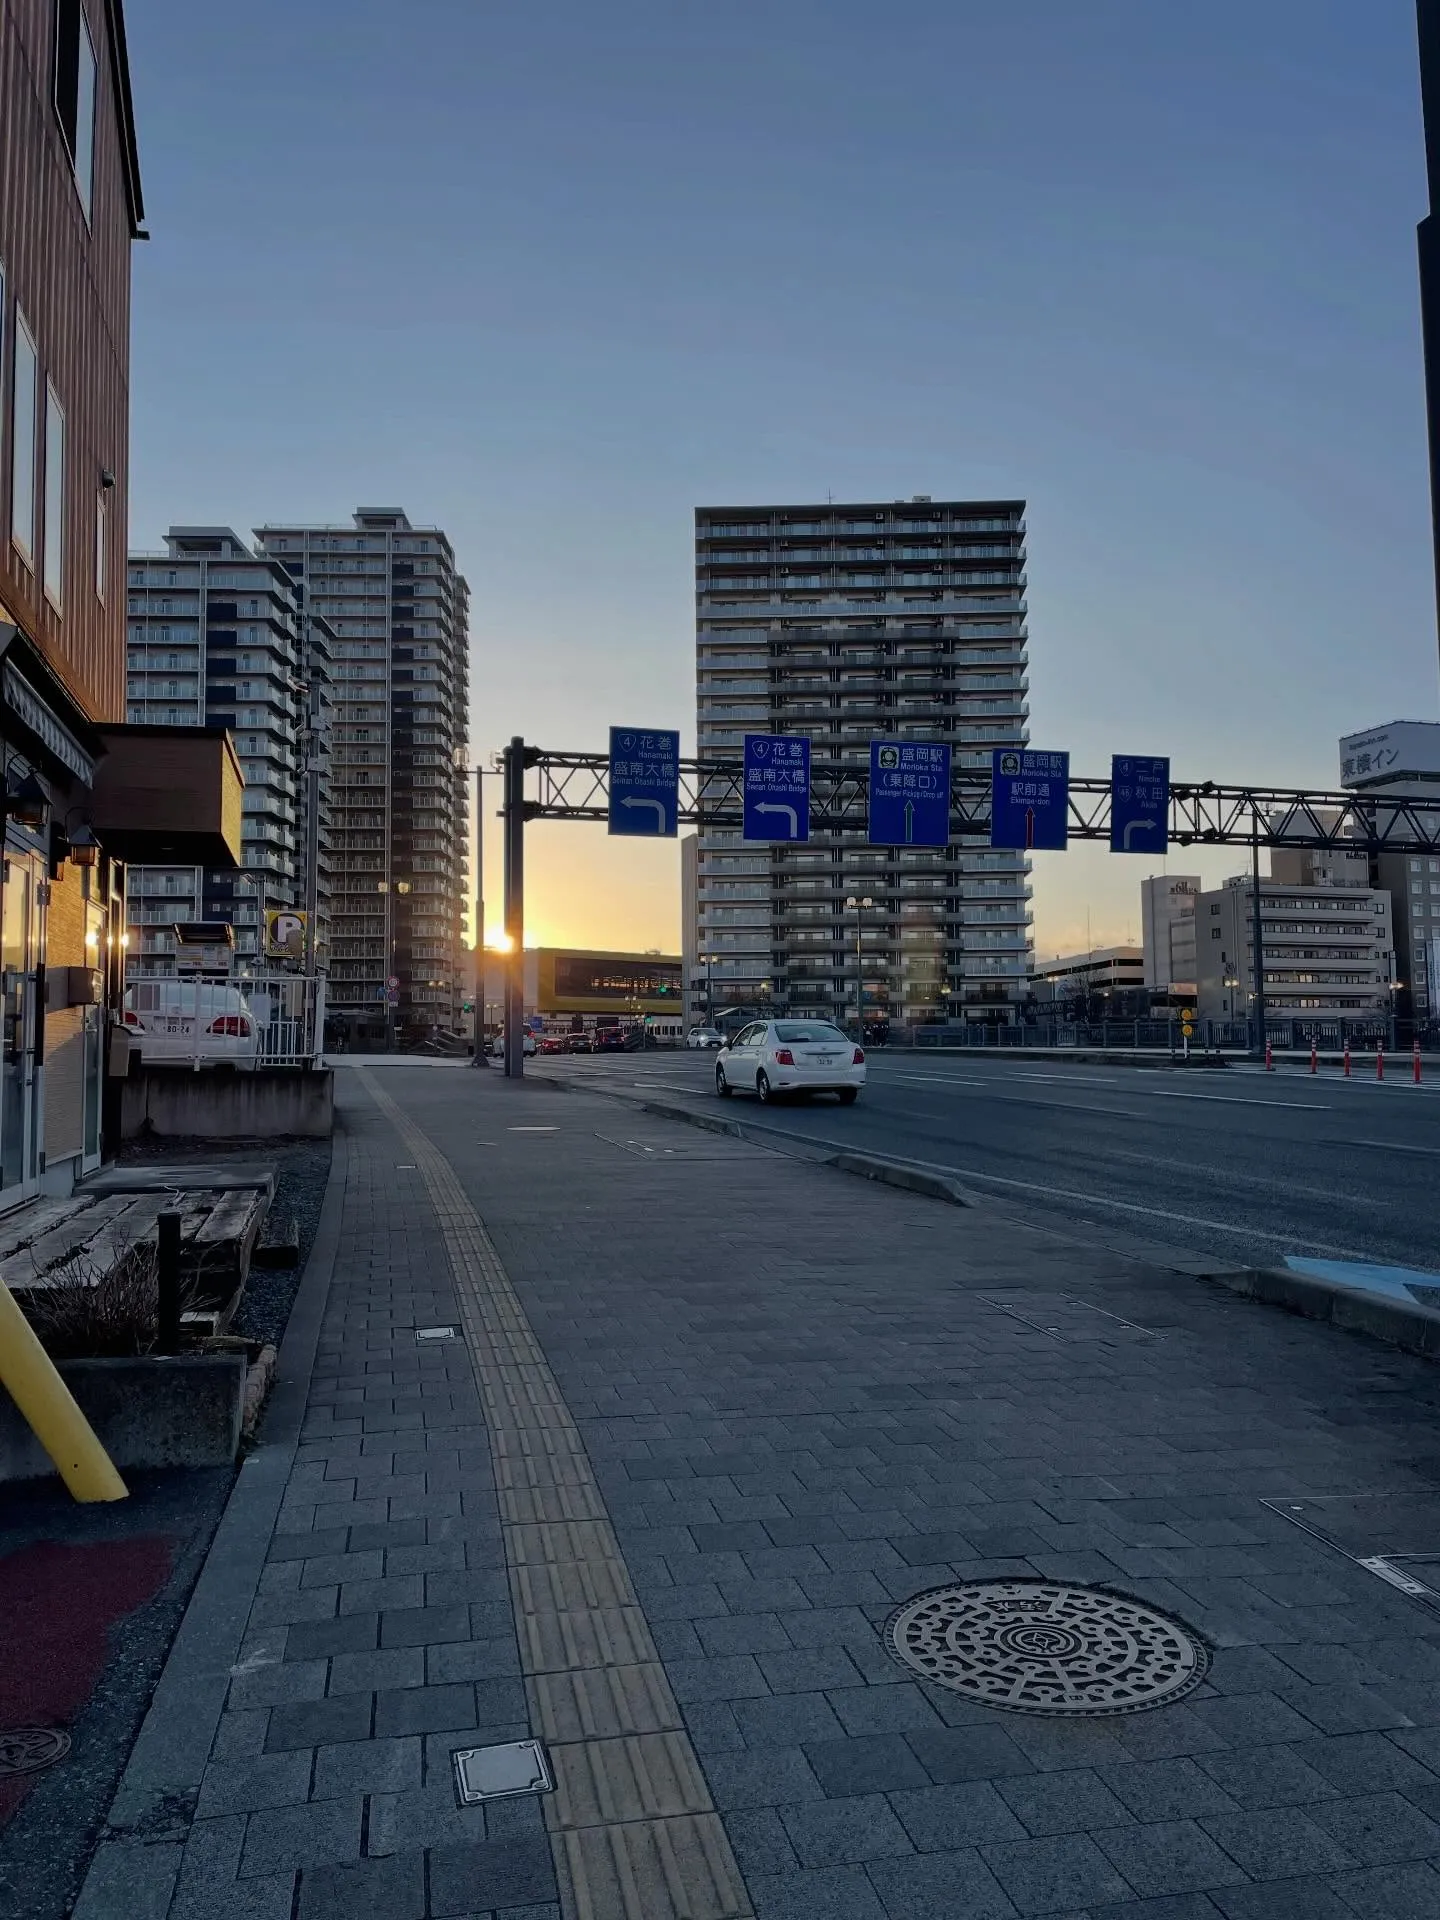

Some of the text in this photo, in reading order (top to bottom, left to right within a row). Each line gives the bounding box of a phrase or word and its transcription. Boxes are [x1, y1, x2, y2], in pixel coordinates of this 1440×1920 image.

[640, 735, 672, 750] 花巻
[773, 742, 803, 757] 花巻
[638, 751, 673, 760] Hanamaki
[771, 757, 804, 767] Hanamaki
[902, 748, 943, 763] 盛岡駅
[1023, 753, 1063, 769] 盛岡駅
[614, 761, 675, 778] 盛南大橋
[900, 762, 929, 772] Morioka
[1343, 749, 1399, 779] 東横イン
[748, 768, 806, 784] 盛南大橋
[1021, 768, 1048, 778] Morioka
[656, 778, 676, 789] Bridge
[788, 784, 807, 794] Bridge
[1011, 782, 1050, 797] 駅前通
[1135, 786, 1163, 800] 秋田
[277, 916, 302, 943] P
